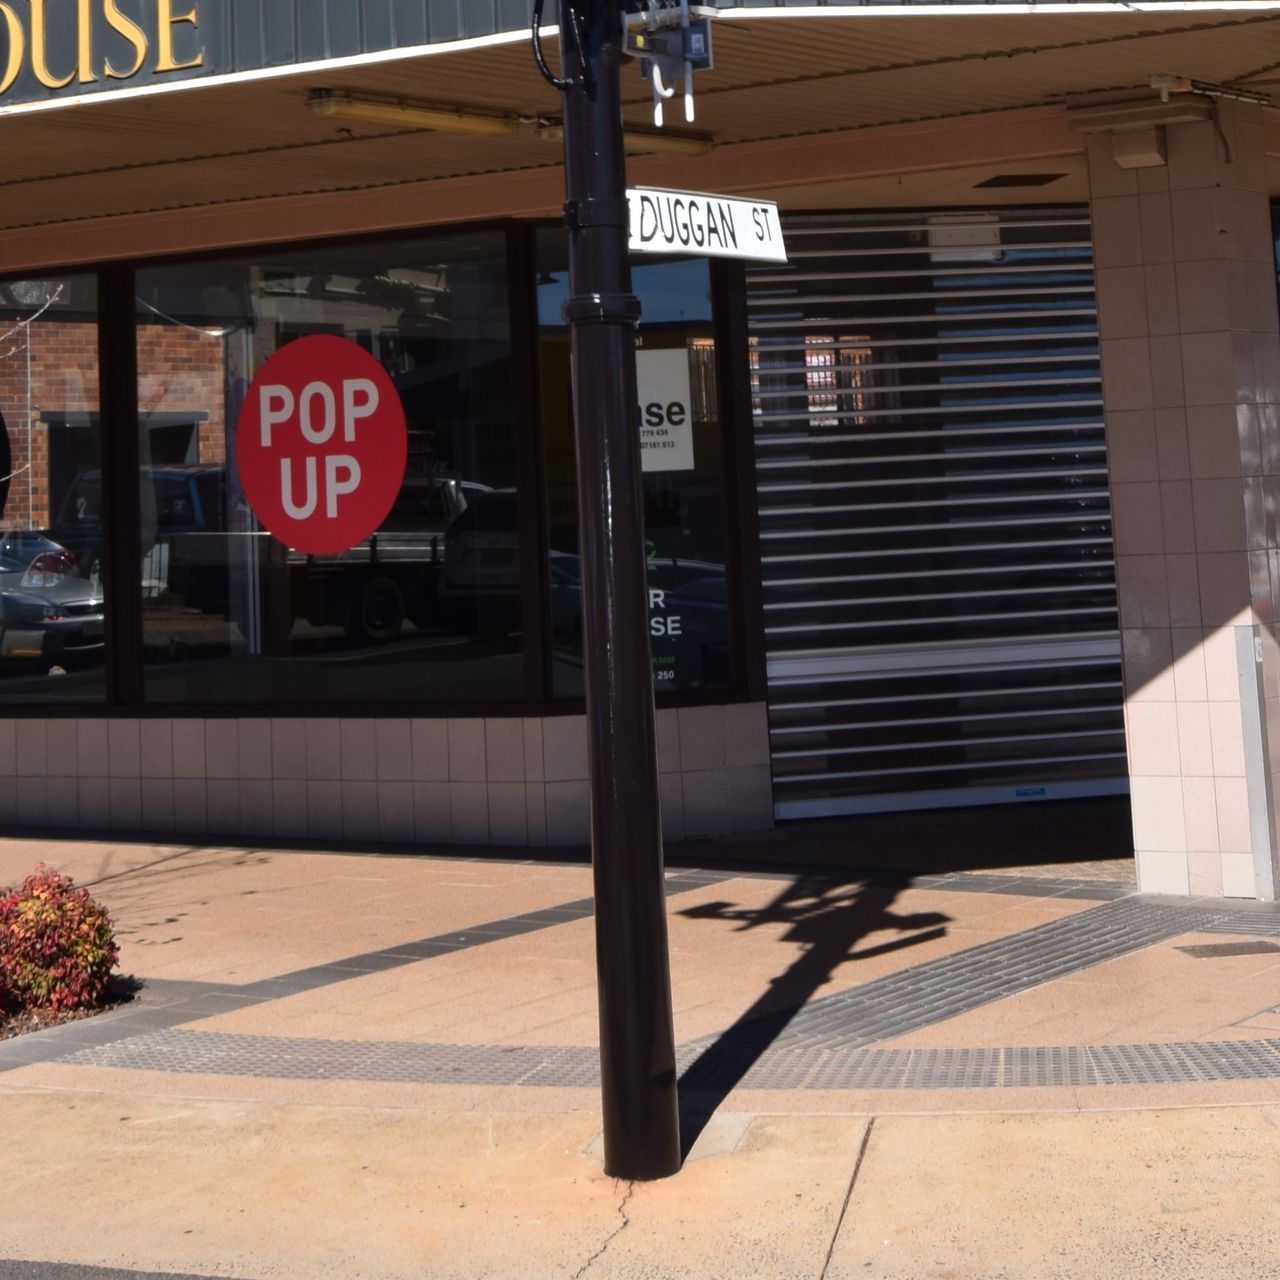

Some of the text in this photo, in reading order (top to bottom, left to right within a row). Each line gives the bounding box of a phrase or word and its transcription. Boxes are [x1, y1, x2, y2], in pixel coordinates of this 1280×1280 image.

[640, 195, 771, 249] DUGGAN ST
[259, 378, 380, 447] POP
[280, 454, 362, 520] UP
